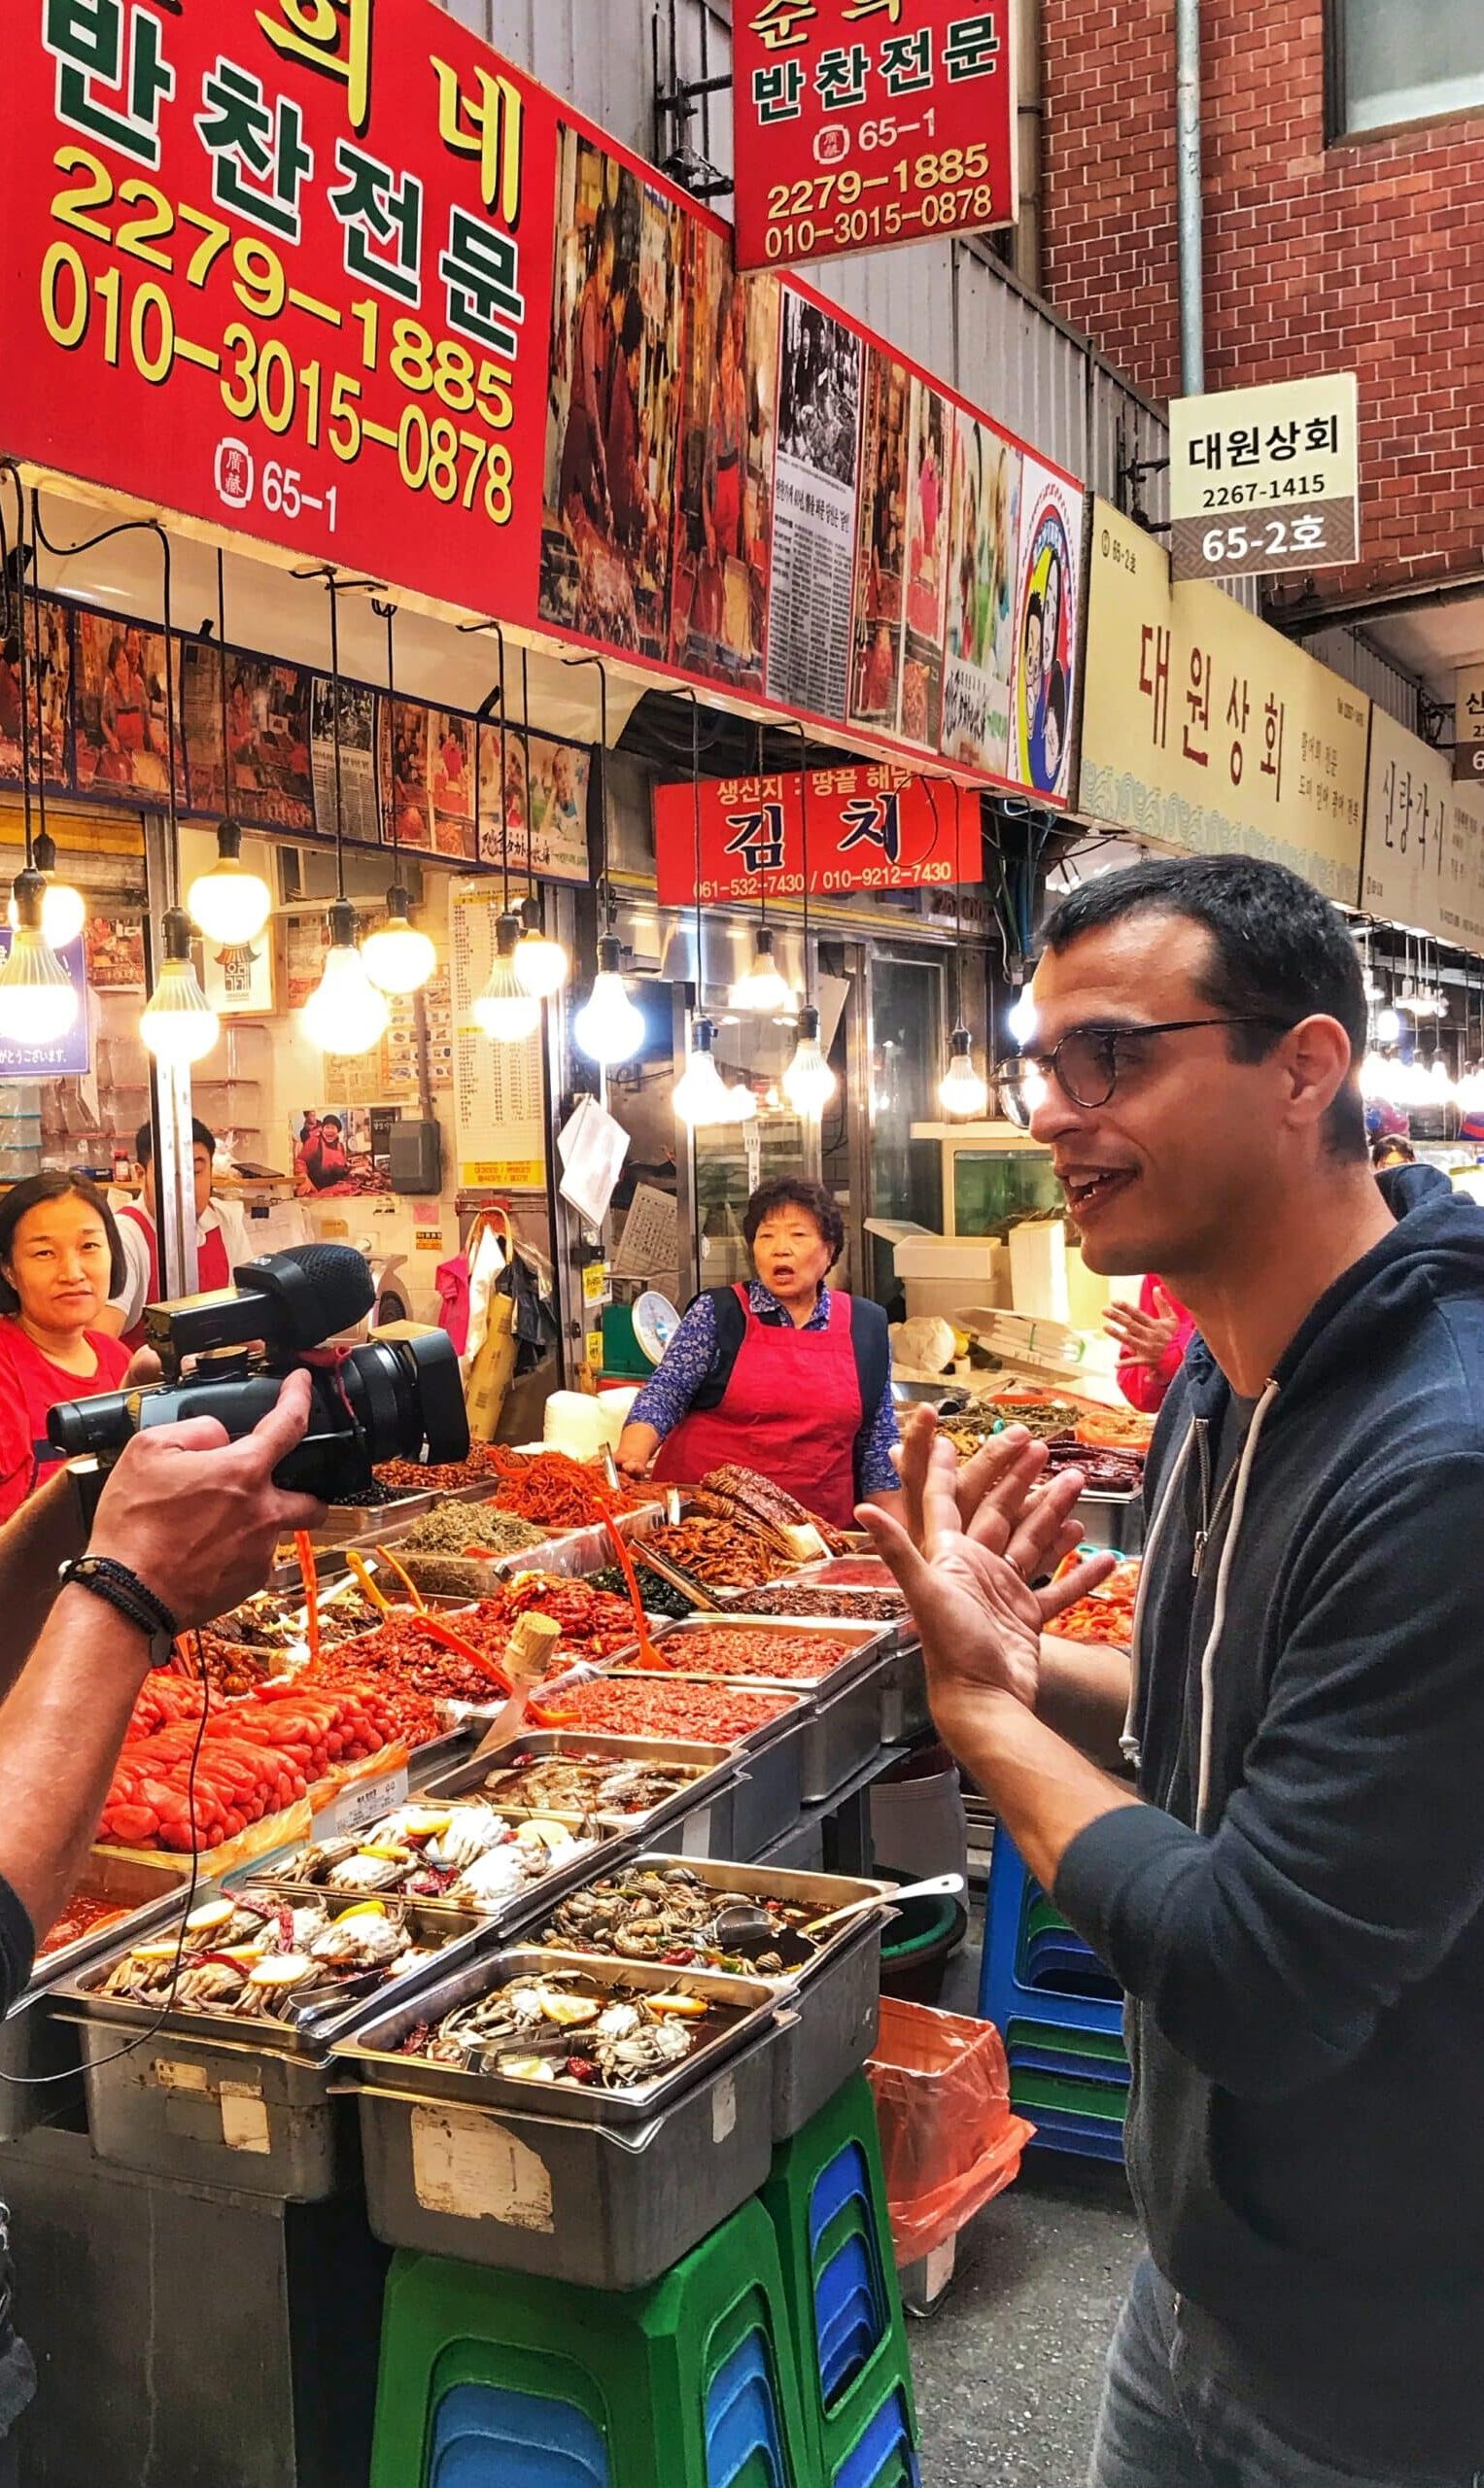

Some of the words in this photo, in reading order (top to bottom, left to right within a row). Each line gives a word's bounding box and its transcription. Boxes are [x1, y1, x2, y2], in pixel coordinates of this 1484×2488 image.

[752, 13, 1000, 125] 반찬전문
[858, 107, 935, 151] 65-1
[43, 0, 524, 361] 반찬전문
[767, 143, 989, 220] 2279-1885
[765, 185, 992, 258] 010-3015-0878
[51, 146, 514, 430] 2279-1885
[40, 240, 514, 525] 010-3015-0878
[1189, 415, 1337, 470] 대원상회
[262, 461, 337, 533] 65-1
[1202, 474, 1325, 508] 2267-1415
[1202, 514, 1327, 562] 65-2호
[1139, 624, 1285, 803] 대원상회
[716, 776, 783, 805] 생산지
[811, 769, 857, 796] 땅끝
[724, 793, 901, 874] 김치
[693, 874, 805, 899] 061-532-7430
[823, 862, 950, 890] 010-9212-7430
